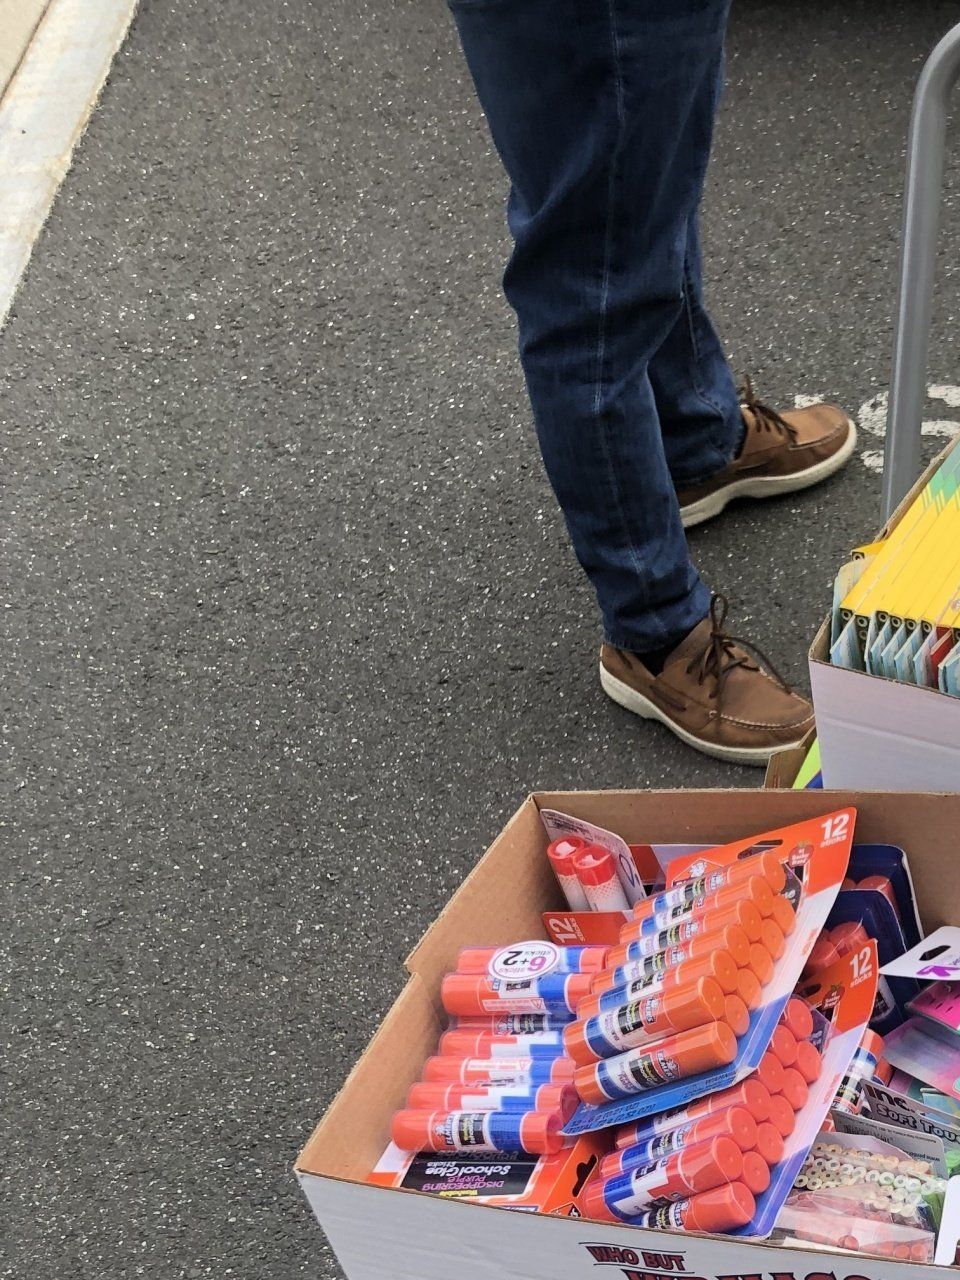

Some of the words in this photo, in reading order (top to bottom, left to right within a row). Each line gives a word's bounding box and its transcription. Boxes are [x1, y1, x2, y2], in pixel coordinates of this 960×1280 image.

[821, 813, 850, 840] 12
[820, 835, 847, 848] sticks
[548, 918, 578, 944] 12
[569, 917, 585, 942] sticks
[849, 946, 873, 979] 12
[850, 970, 873, 988] sticks
[424, 1167, 460, 1178] Glue
[461, 1165, 511, 1176] School
[585, 1245, 639, 1266] WHO
[642, 1251, 686, 1272] BUT
